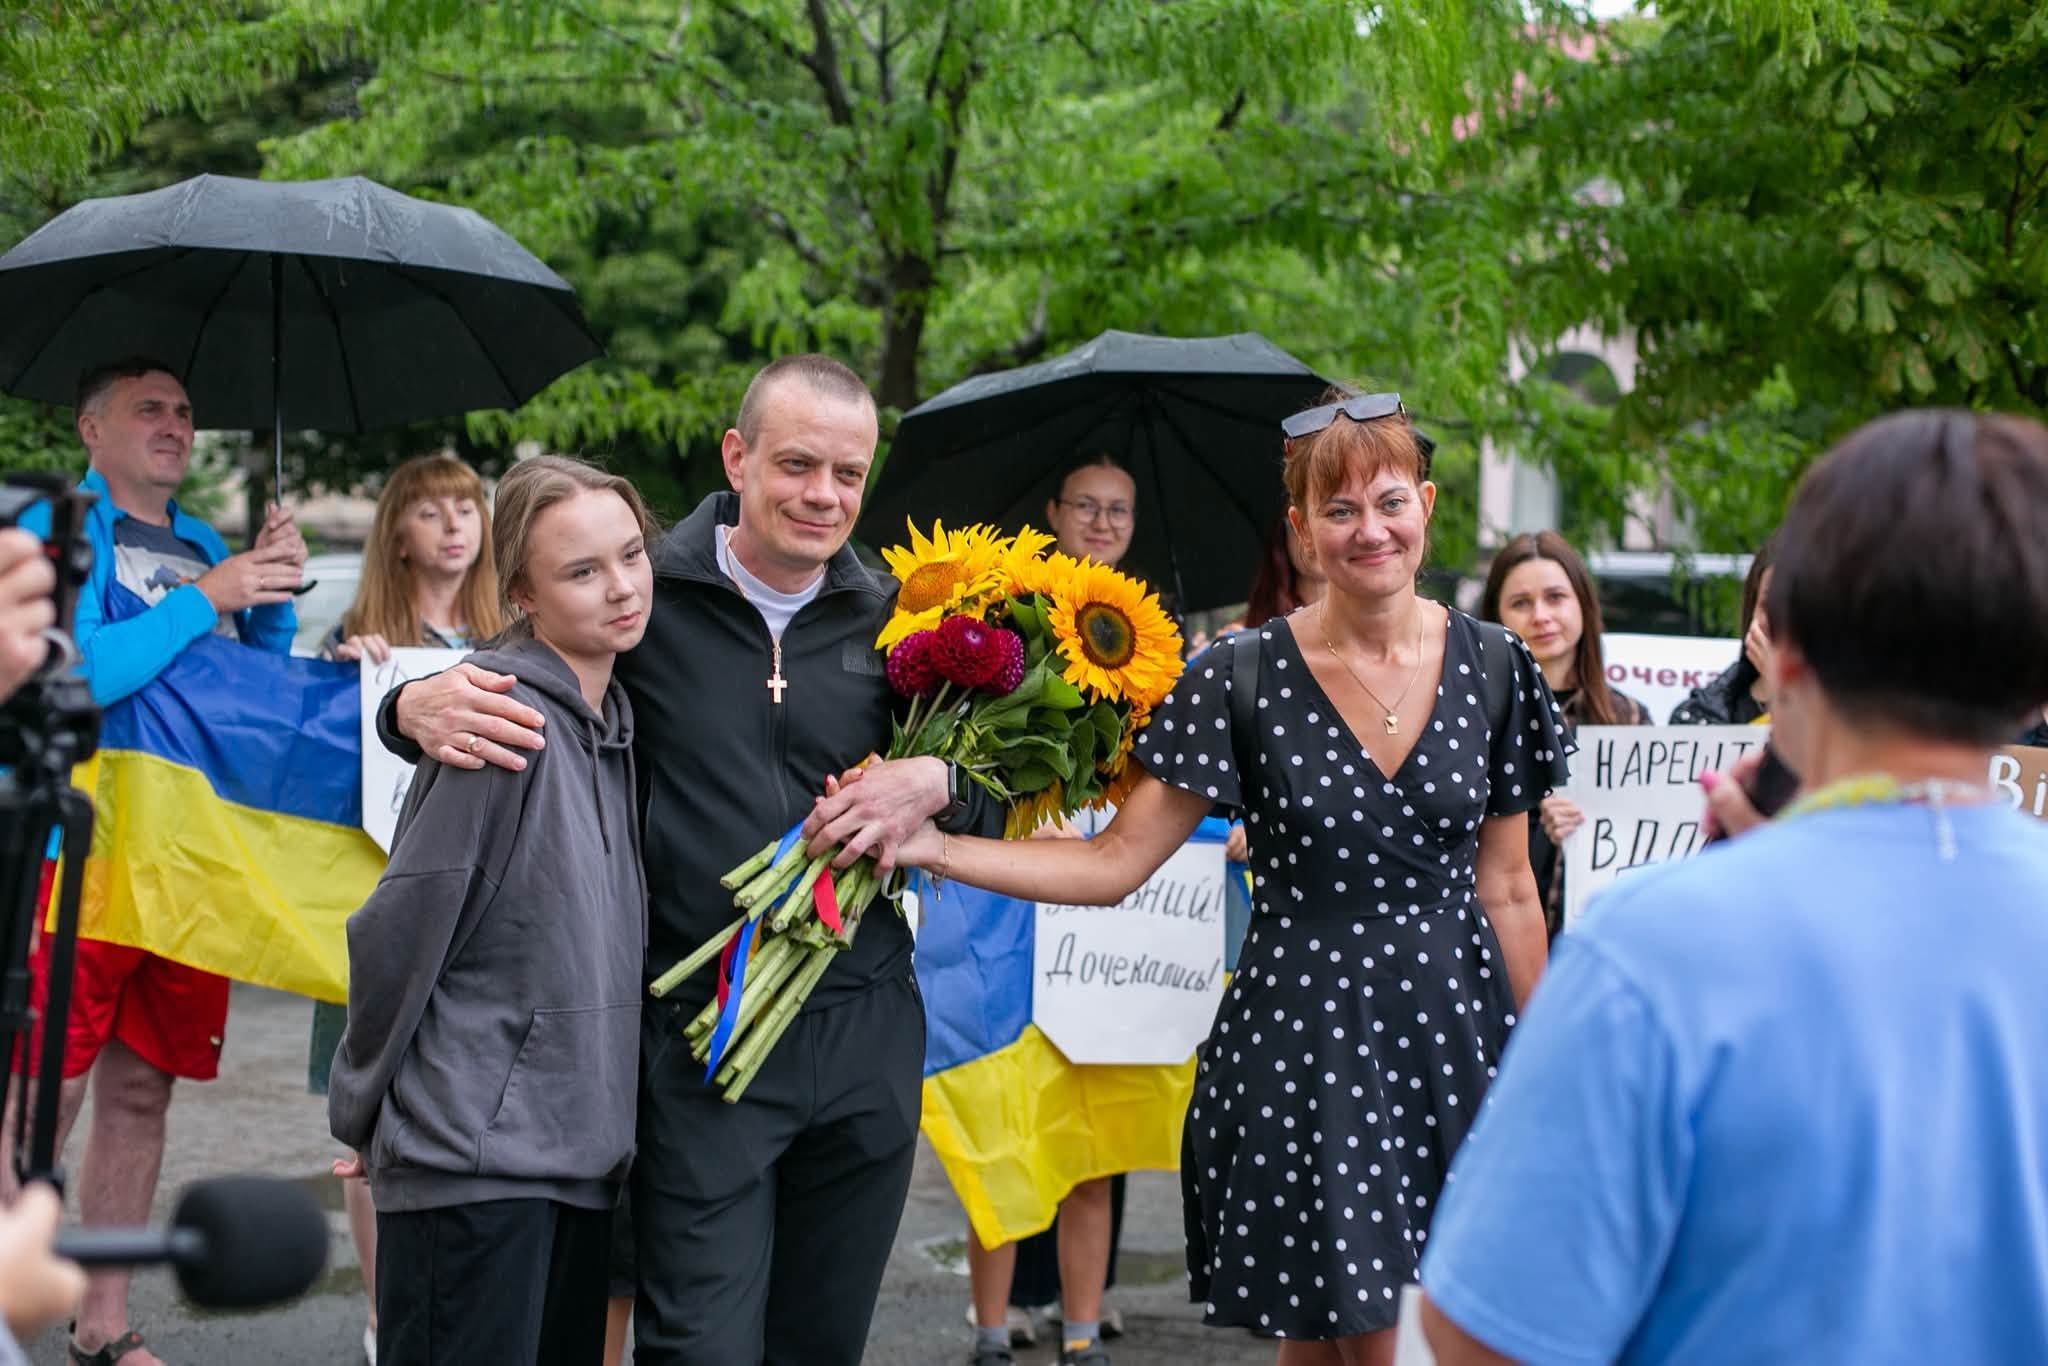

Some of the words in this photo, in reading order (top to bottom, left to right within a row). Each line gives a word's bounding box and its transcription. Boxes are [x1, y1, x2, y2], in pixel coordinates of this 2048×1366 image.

[1606, 664, 1722, 688] очек
[1596, 738, 1769, 791] НАРЕШТ
[1988, 754, 2048, 816] Ві
[1045, 932, 1222, 992] Дочекались!
